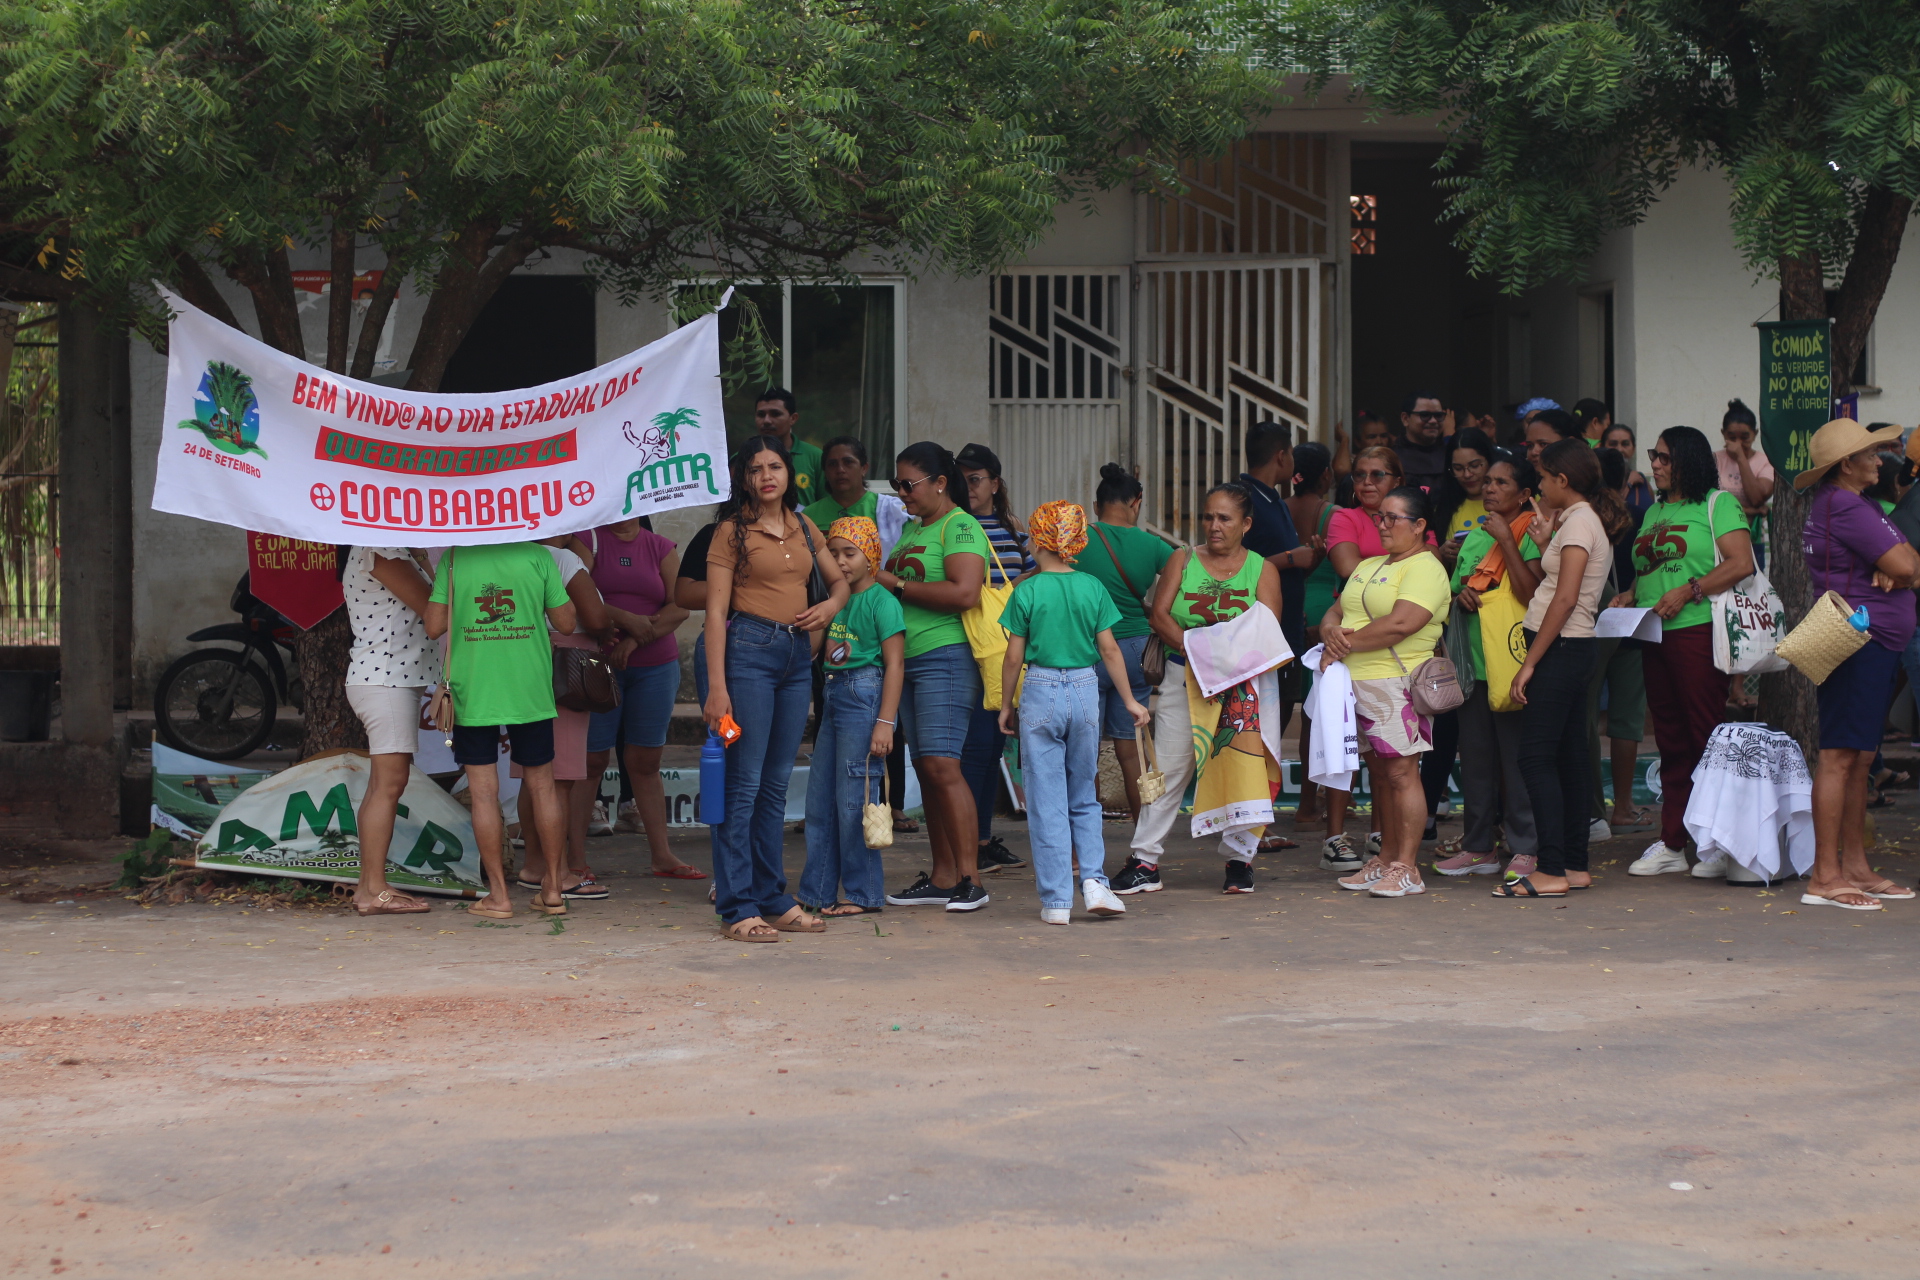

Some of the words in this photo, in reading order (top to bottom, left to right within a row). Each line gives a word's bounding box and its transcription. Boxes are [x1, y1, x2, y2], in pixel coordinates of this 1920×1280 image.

[1772, 336, 1823, 357] COMIDA
[1772, 362, 1783, 373] DE
[1787, 361, 1825, 373] VERDADE
[1769, 377, 1788, 393] NO
[1791, 375, 1830, 394] CAMPO
[292, 372, 338, 414] BEM
[346, 388, 416, 430] VIND@
[416, 405, 453, 433] AO
[457, 407, 495, 433] DIA
[500, 382, 600, 430] ESTADUAL
[600, 366, 643, 408] DAS
[1770, 398, 1777, 410] E
[183, 442, 197, 456] 24
[198, 446, 213, 460] DE
[214, 454, 262, 479] SETEMBRO
[324, 430, 530, 474] QUEBRADEIRAS
[536, 432, 570, 462] DE
[621, 452, 720, 516] AMTR
[339, 480, 423, 527] COCO
[429, 479, 564, 531] BABAÇU
[255, 535, 263, 551] É
[268, 537, 289, 551] UM
[257, 551, 297, 570] CALAR
[474, 589, 516, 625] 35
[1737, 728, 1757, 741] Rede
[1757, 731, 1767, 742] de
